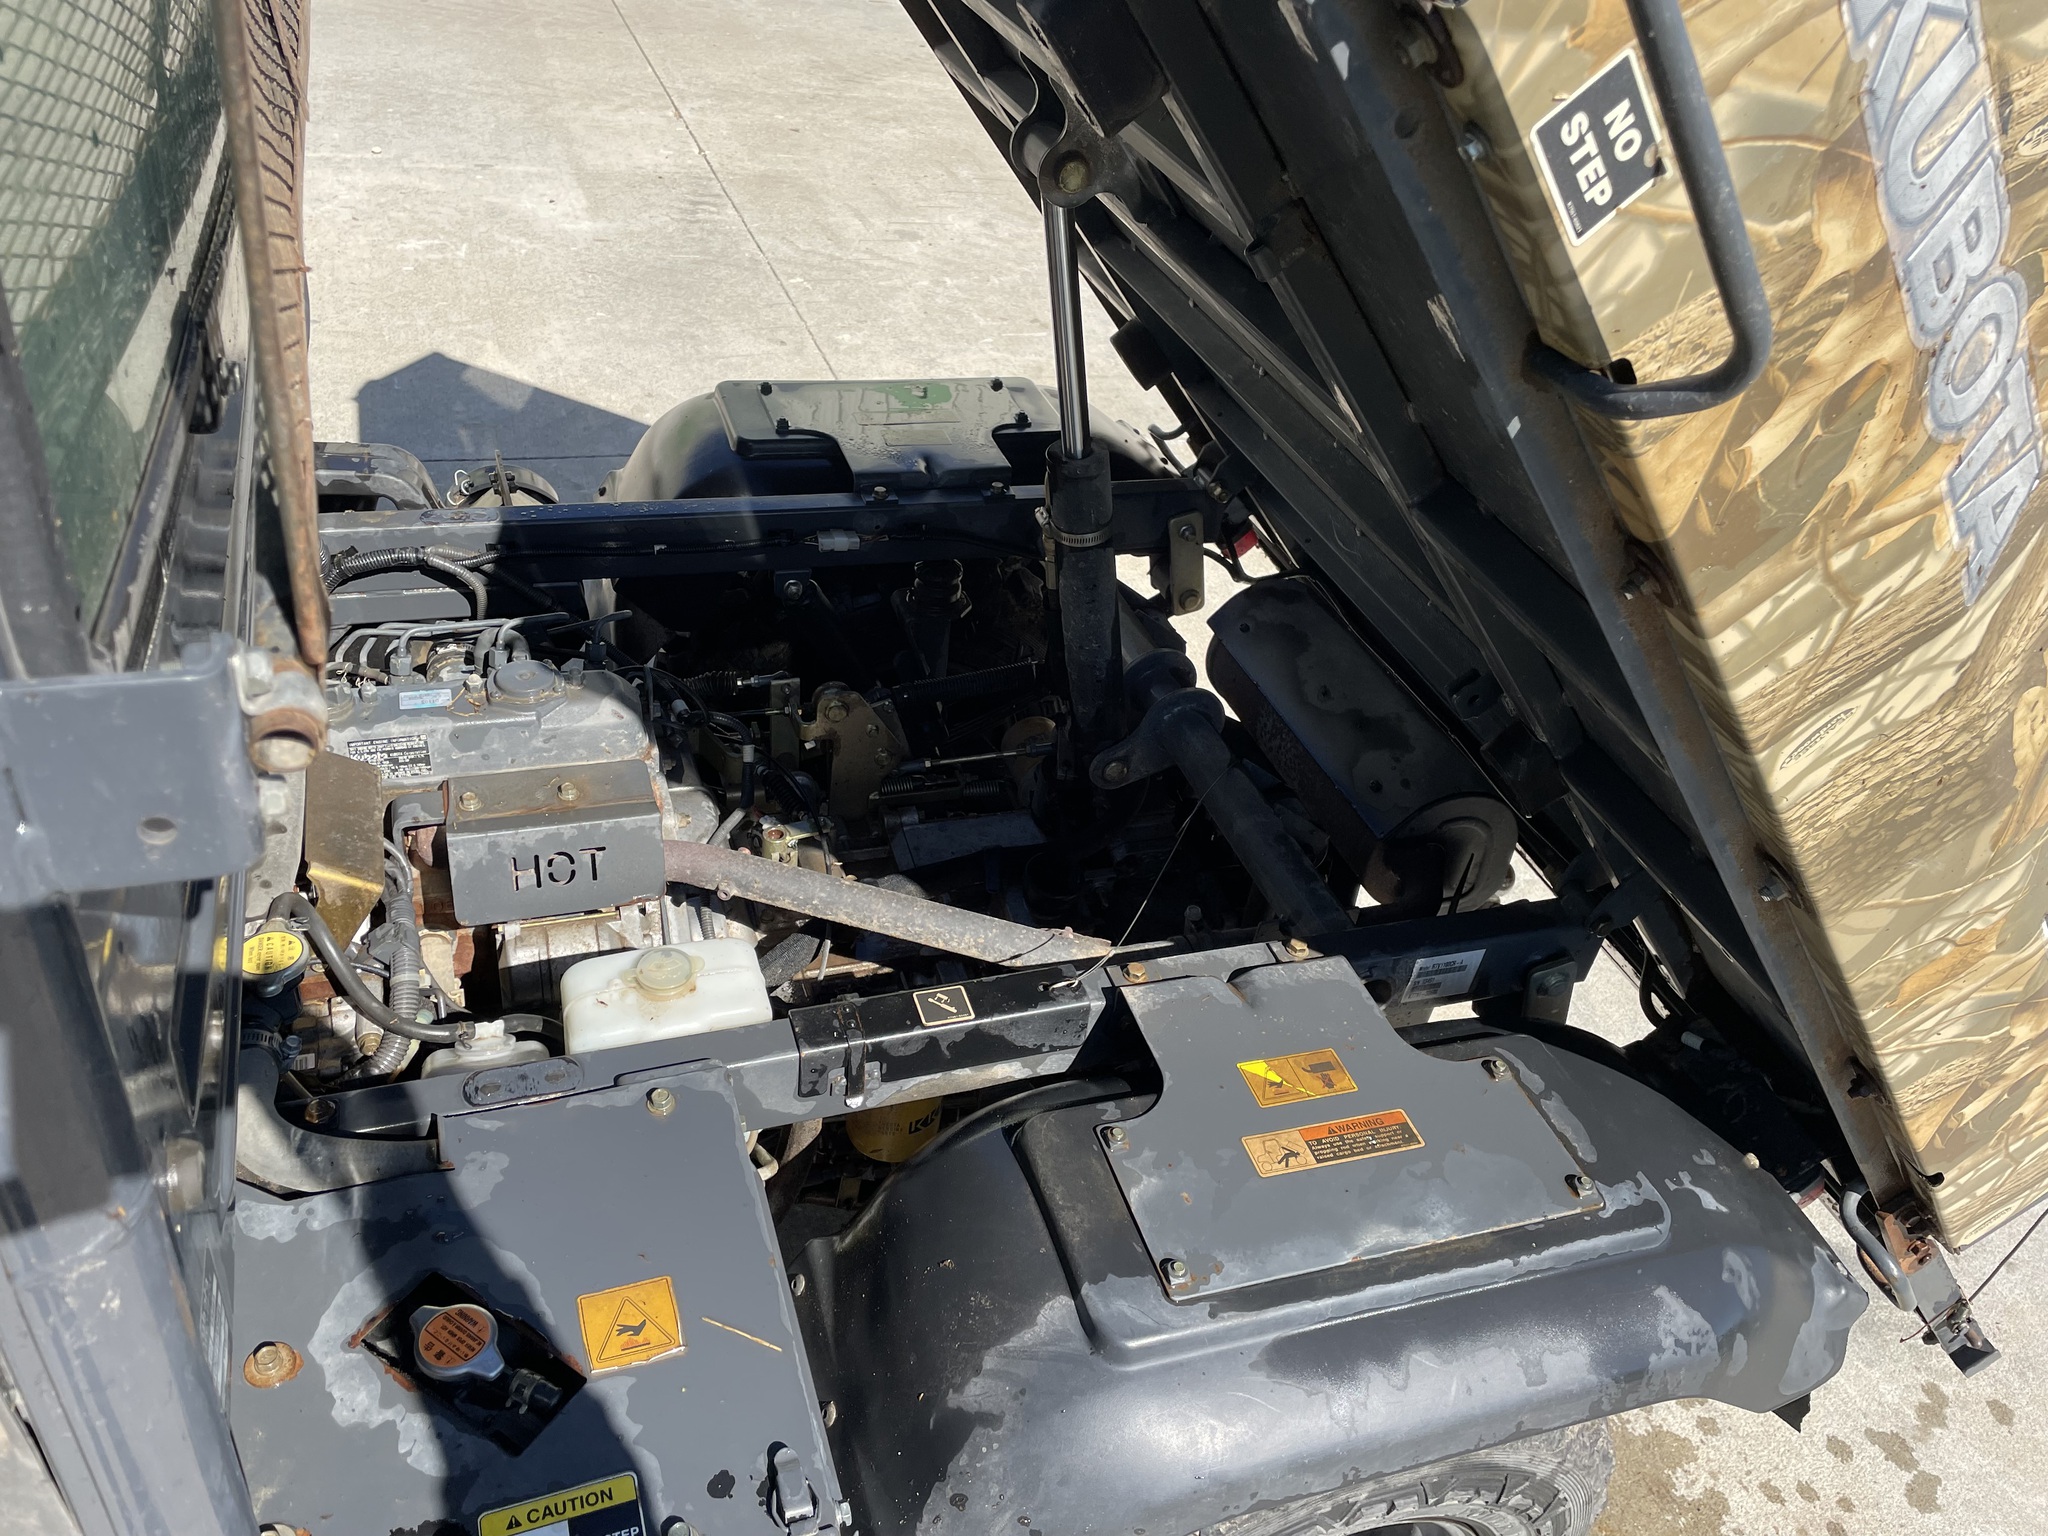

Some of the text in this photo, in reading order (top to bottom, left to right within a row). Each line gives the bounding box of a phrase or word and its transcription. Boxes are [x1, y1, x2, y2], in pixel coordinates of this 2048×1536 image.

[1602, 97, 1643, 162] NO
[1560, 111, 1613, 206] STEP
[511, 846, 606, 891] HOT
[1335, 1118, 1384, 1132] WARNING
[1322, 1136, 1340, 1144] AVOID
[1343, 1130, 1376, 1140] PERSONAL
[1314, 1147, 1339, 1155] propping
[455, 1309, 479, 1327] WARNING
[526, 1487, 613, 1524] CAUTION
[604, 1526, 640, 1536] TEP
